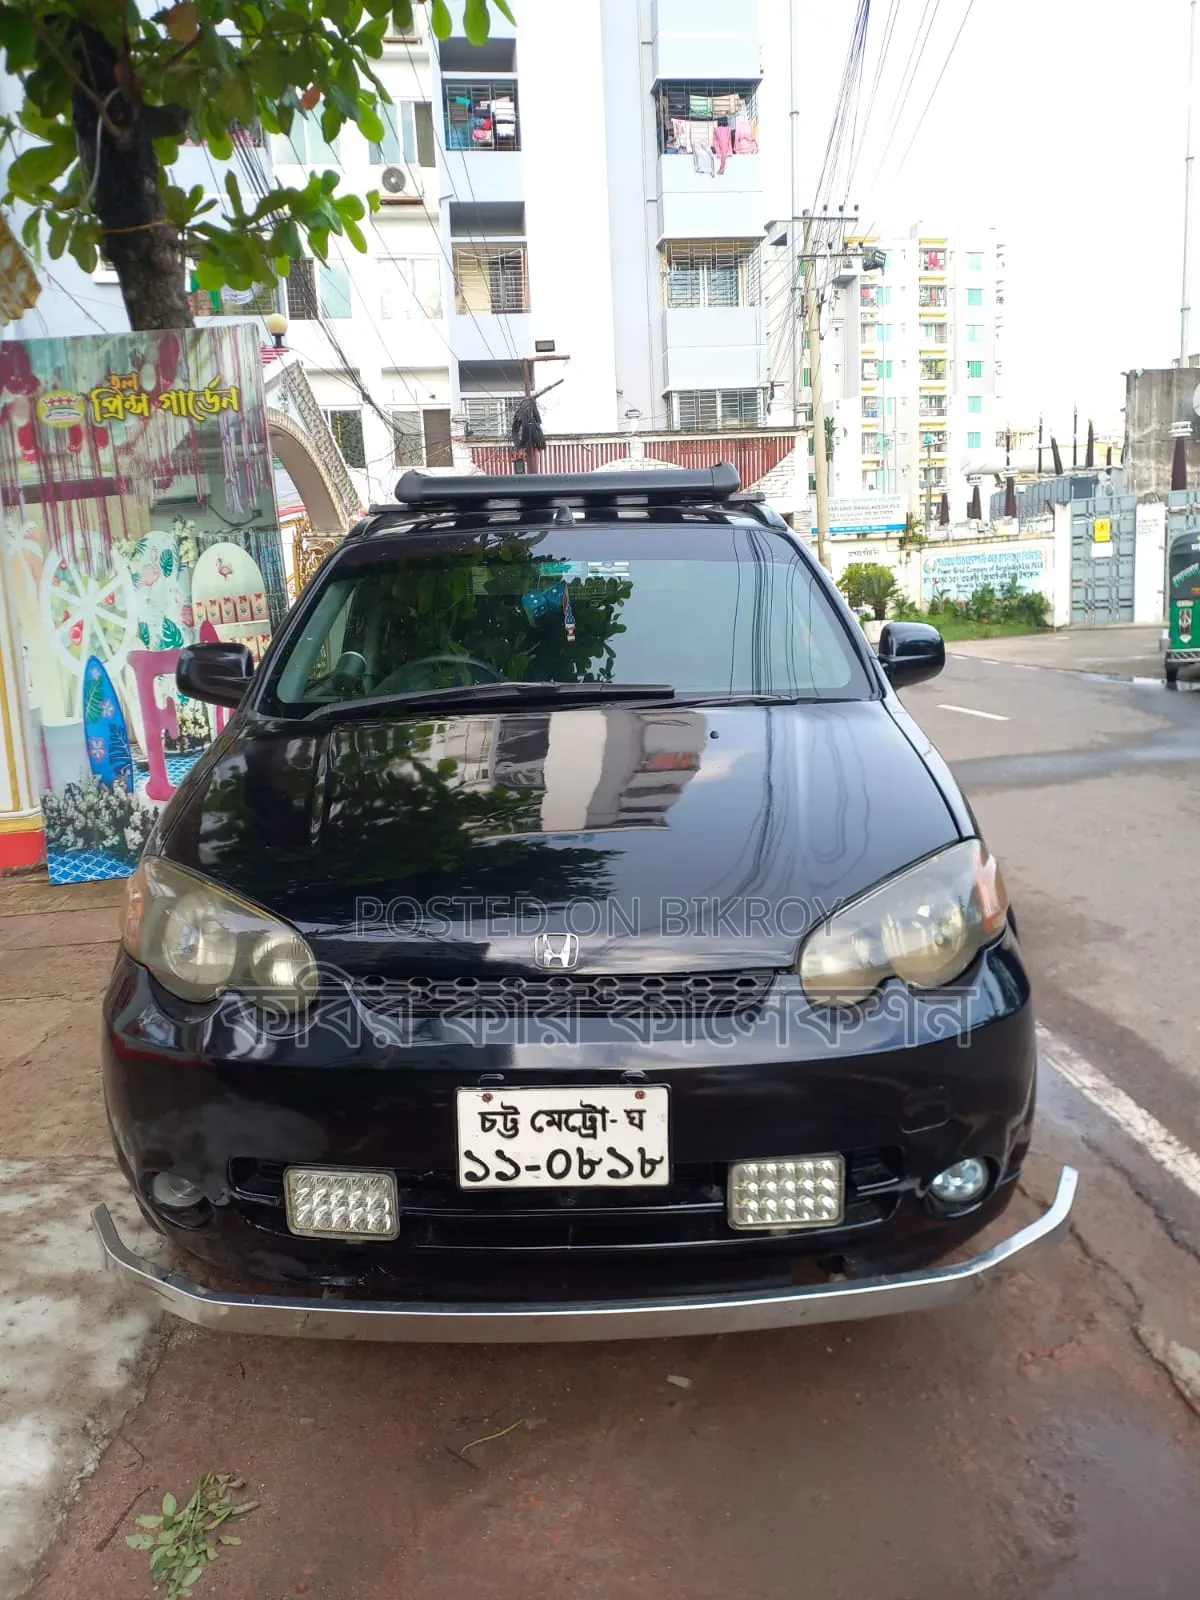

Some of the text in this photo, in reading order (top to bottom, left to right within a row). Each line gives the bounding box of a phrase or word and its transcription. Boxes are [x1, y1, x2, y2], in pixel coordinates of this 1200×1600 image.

[90, 374, 240, 423] প্রিন্স গার্ডেন
[624, 1108, 647, 1131] ঘ
[463, 1146, 664, 1183] ১১-০৮১৮
